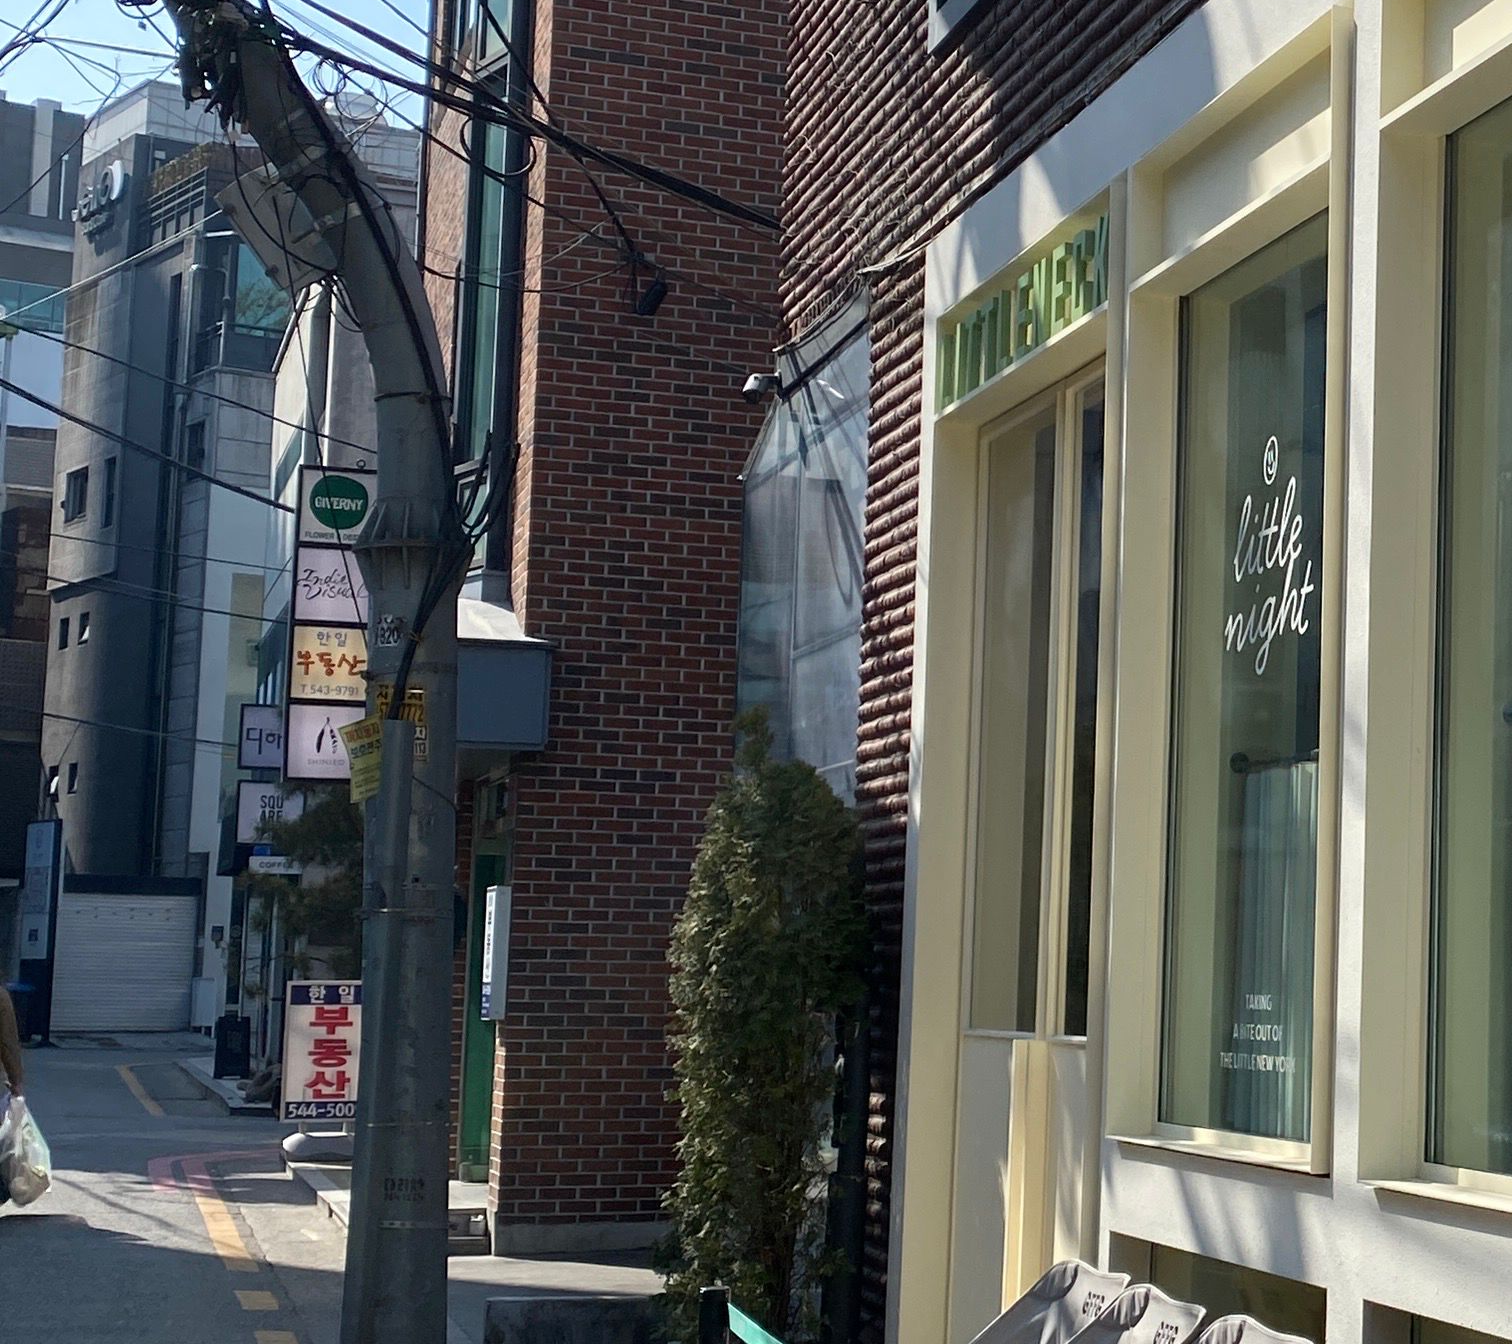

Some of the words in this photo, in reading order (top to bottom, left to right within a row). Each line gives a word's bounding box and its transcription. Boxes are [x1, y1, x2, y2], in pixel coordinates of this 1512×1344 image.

[935, 208, 1109, 414] LITTLENECK
[314, 496, 364, 511] GIVERNY
[1234, 475, 1303, 583] little
[1225, 559, 1315, 675] night
[296, 650, 366, 676] 부동산
[1245, 994, 1273, 1010] TAKING
[1255, 1024, 1272, 1042] OUT
[305, 1007, 353, 1099] 부동산
[1220, 1052, 1233, 1069] THE
[1256, 1055, 1274, 1072] NEW
